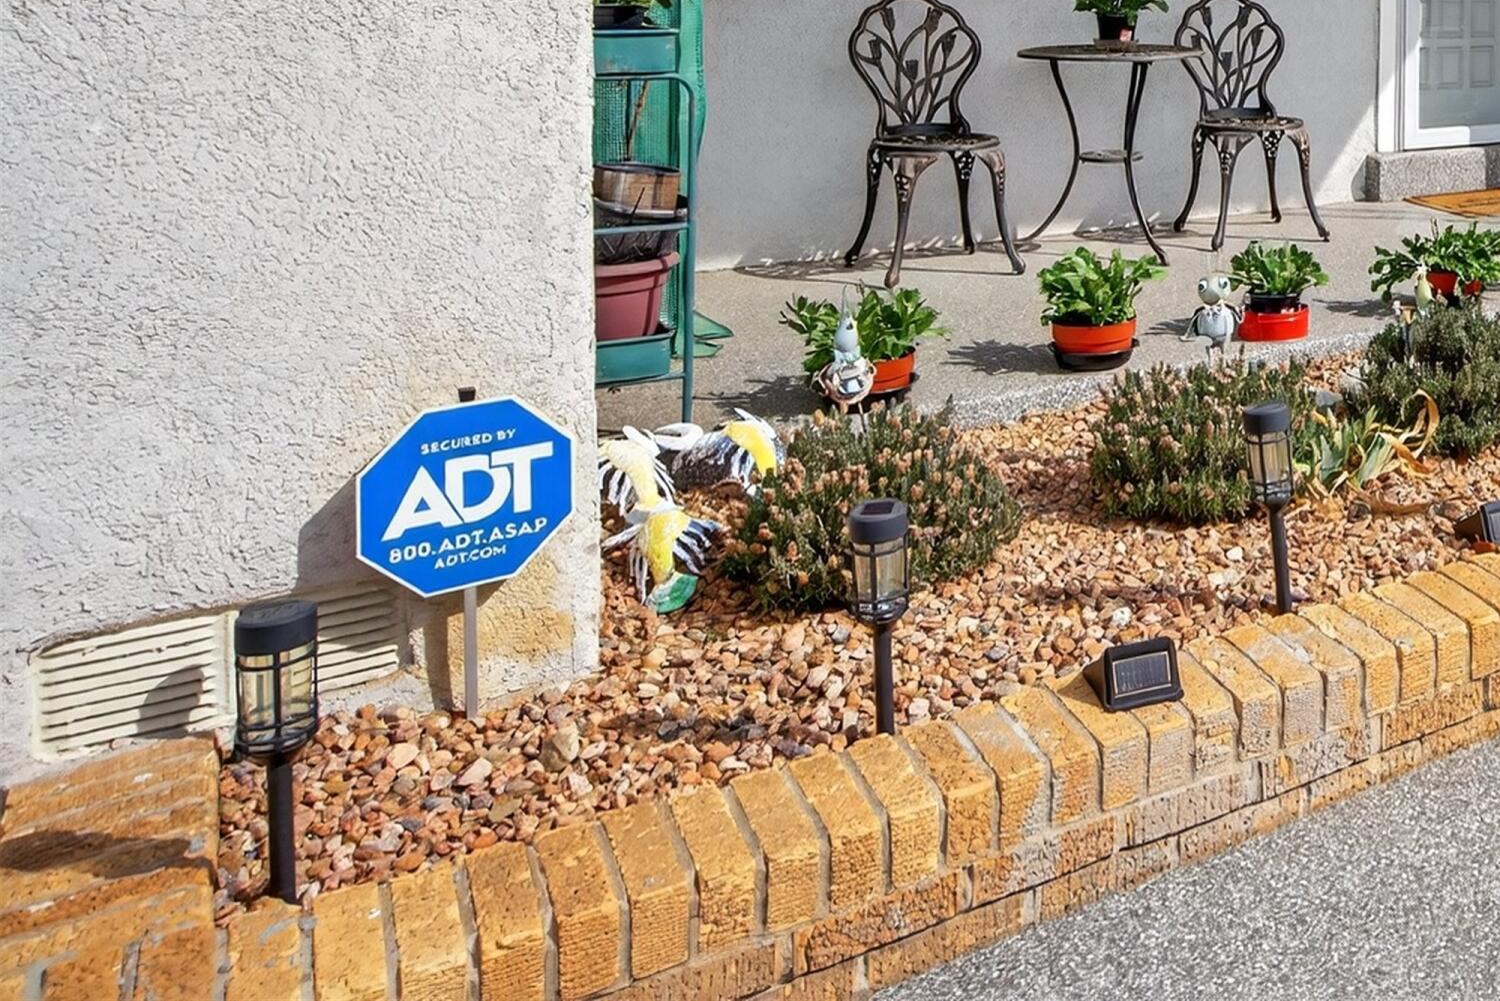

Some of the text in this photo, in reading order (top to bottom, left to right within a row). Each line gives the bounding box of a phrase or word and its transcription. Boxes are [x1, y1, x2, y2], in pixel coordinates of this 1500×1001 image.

[420, 428, 516, 454] SECURED BY
[381, 441, 554, 542] ADT
[389, 517, 548, 564] 800.ADT.ASAP
[434, 546, 507, 569] ADT.COM
